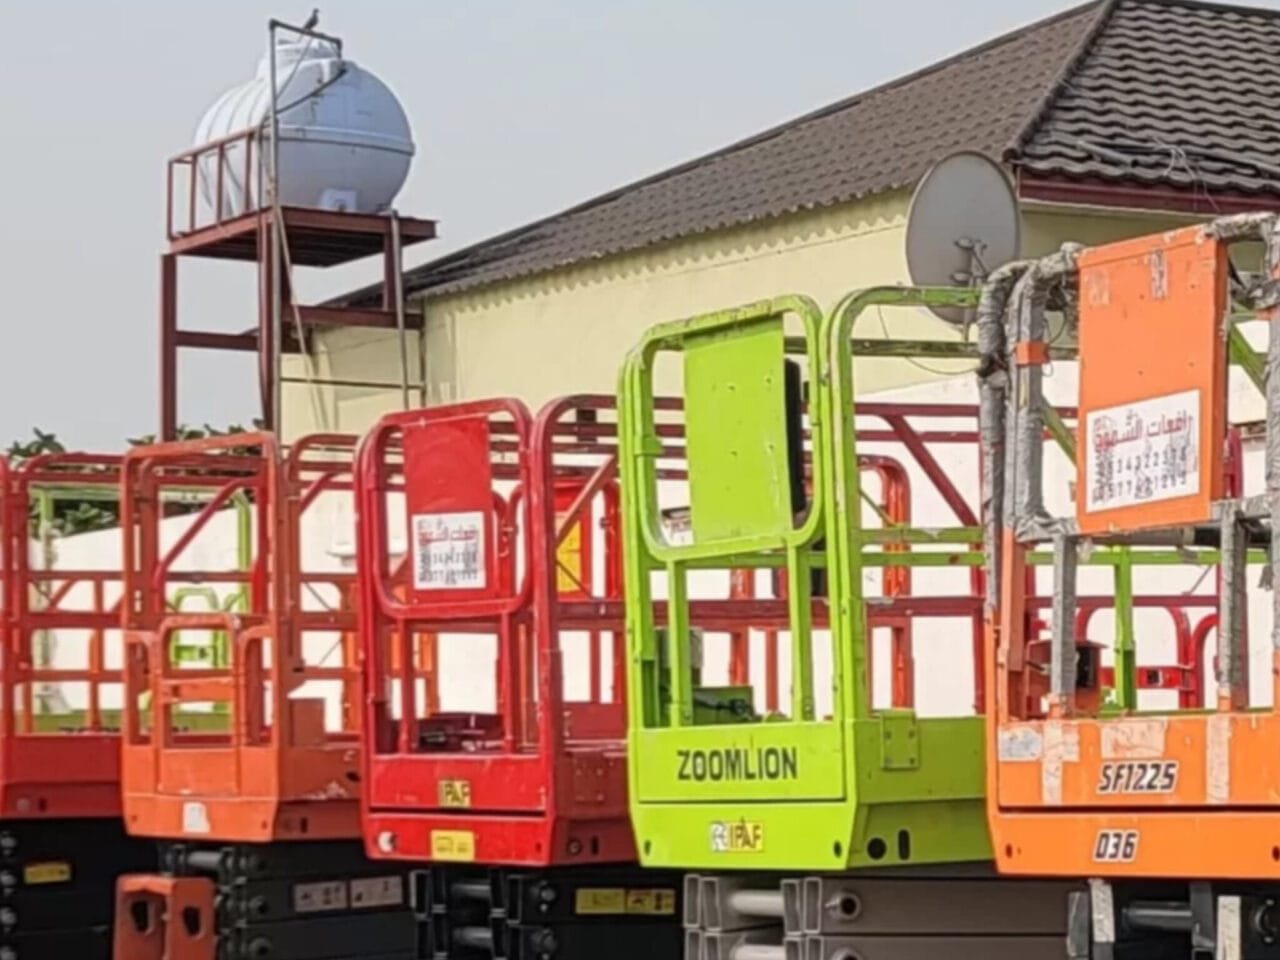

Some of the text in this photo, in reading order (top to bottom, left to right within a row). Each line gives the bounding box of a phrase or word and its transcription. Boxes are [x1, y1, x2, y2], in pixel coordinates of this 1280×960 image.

[677, 747, 798, 781] ZOOMLION
[1098, 762, 1177, 792] SF1225
[1095, 832, 1137, 859] 036
